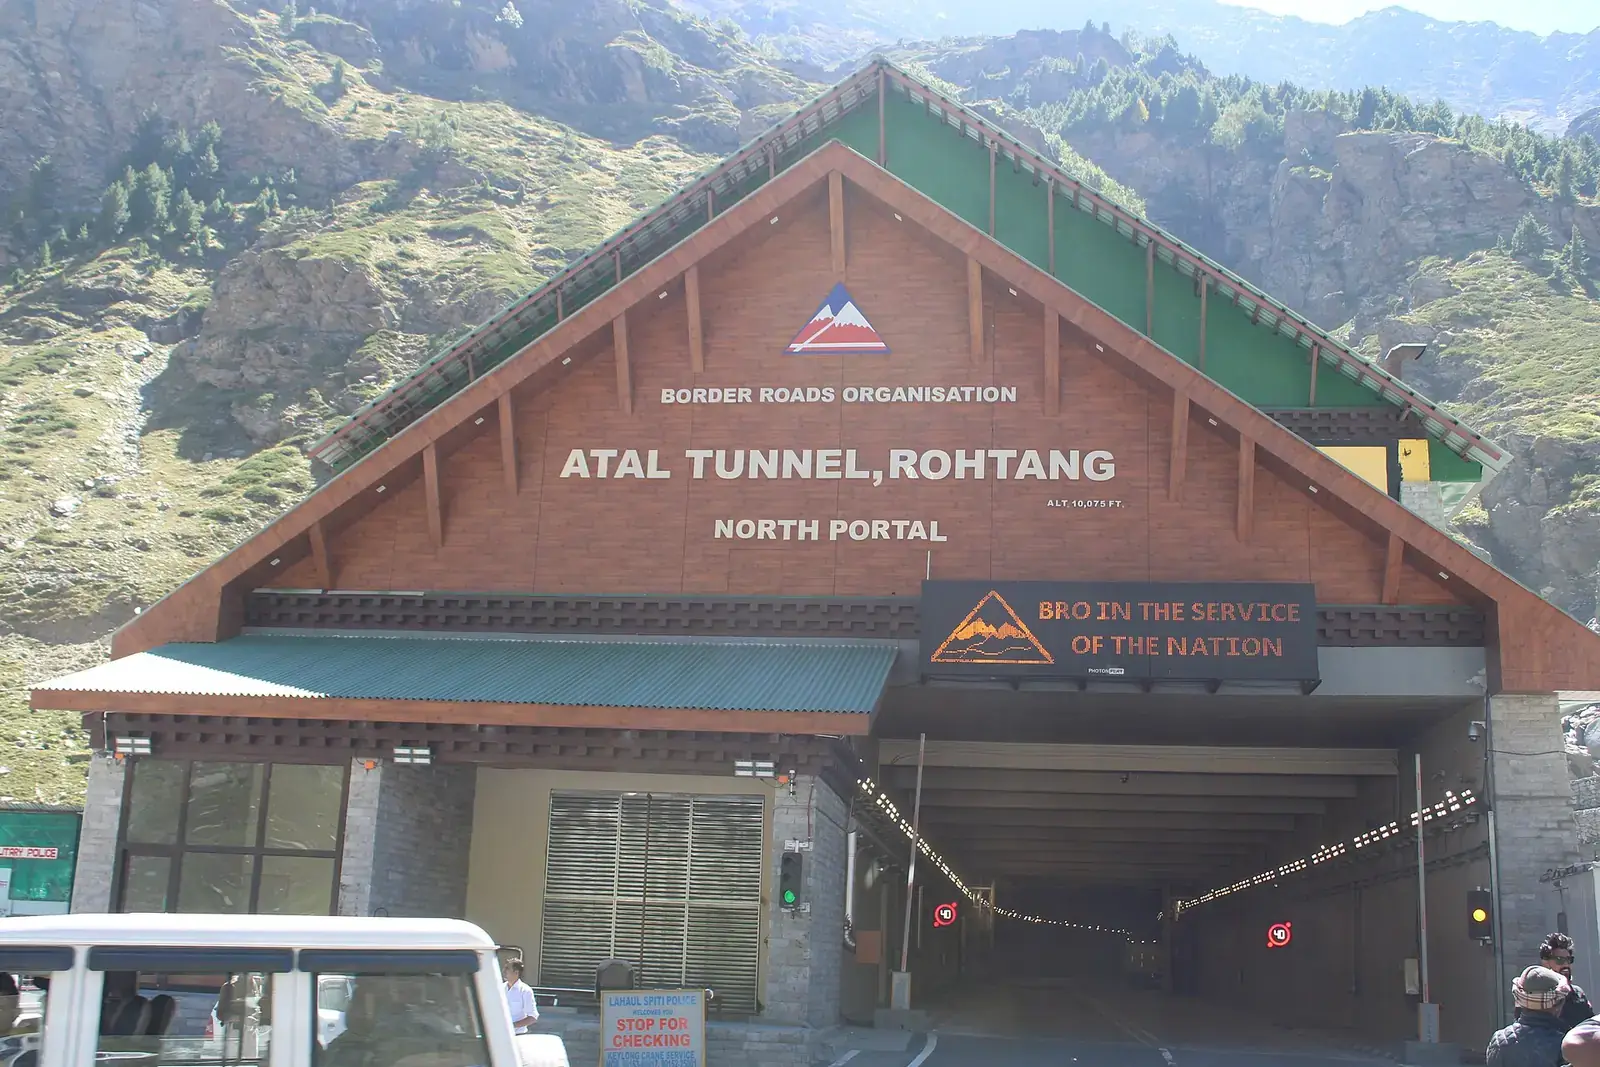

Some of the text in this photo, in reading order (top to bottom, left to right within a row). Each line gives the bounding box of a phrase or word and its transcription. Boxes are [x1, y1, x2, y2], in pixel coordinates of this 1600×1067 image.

[660, 386, 1017, 404] BORDER ROADS ORGANISATION
[559, 449, 671, 479] ATAL
[1047, 499, 1125, 508] ALT. 10,075 FT.
[714, 519, 948, 542] NORTH PORTAL
[1039, 601, 1300, 622] BRO IN THE SERVICE
[1071, 635, 1283, 657] OF THE NATION
[27, 848, 56, 858] POLICE
[940, 909, 952, 920] 40
[1273, 929, 1286, 940] 40
[609, 995, 697, 1007] LAHAUL SPITI POLICE
[616, 1018, 688, 1031] STOP FOR
[612, 1033, 691, 1048] CHECKING
[607, 1050, 695, 1060] KEYLONG CRANE SERVICE
